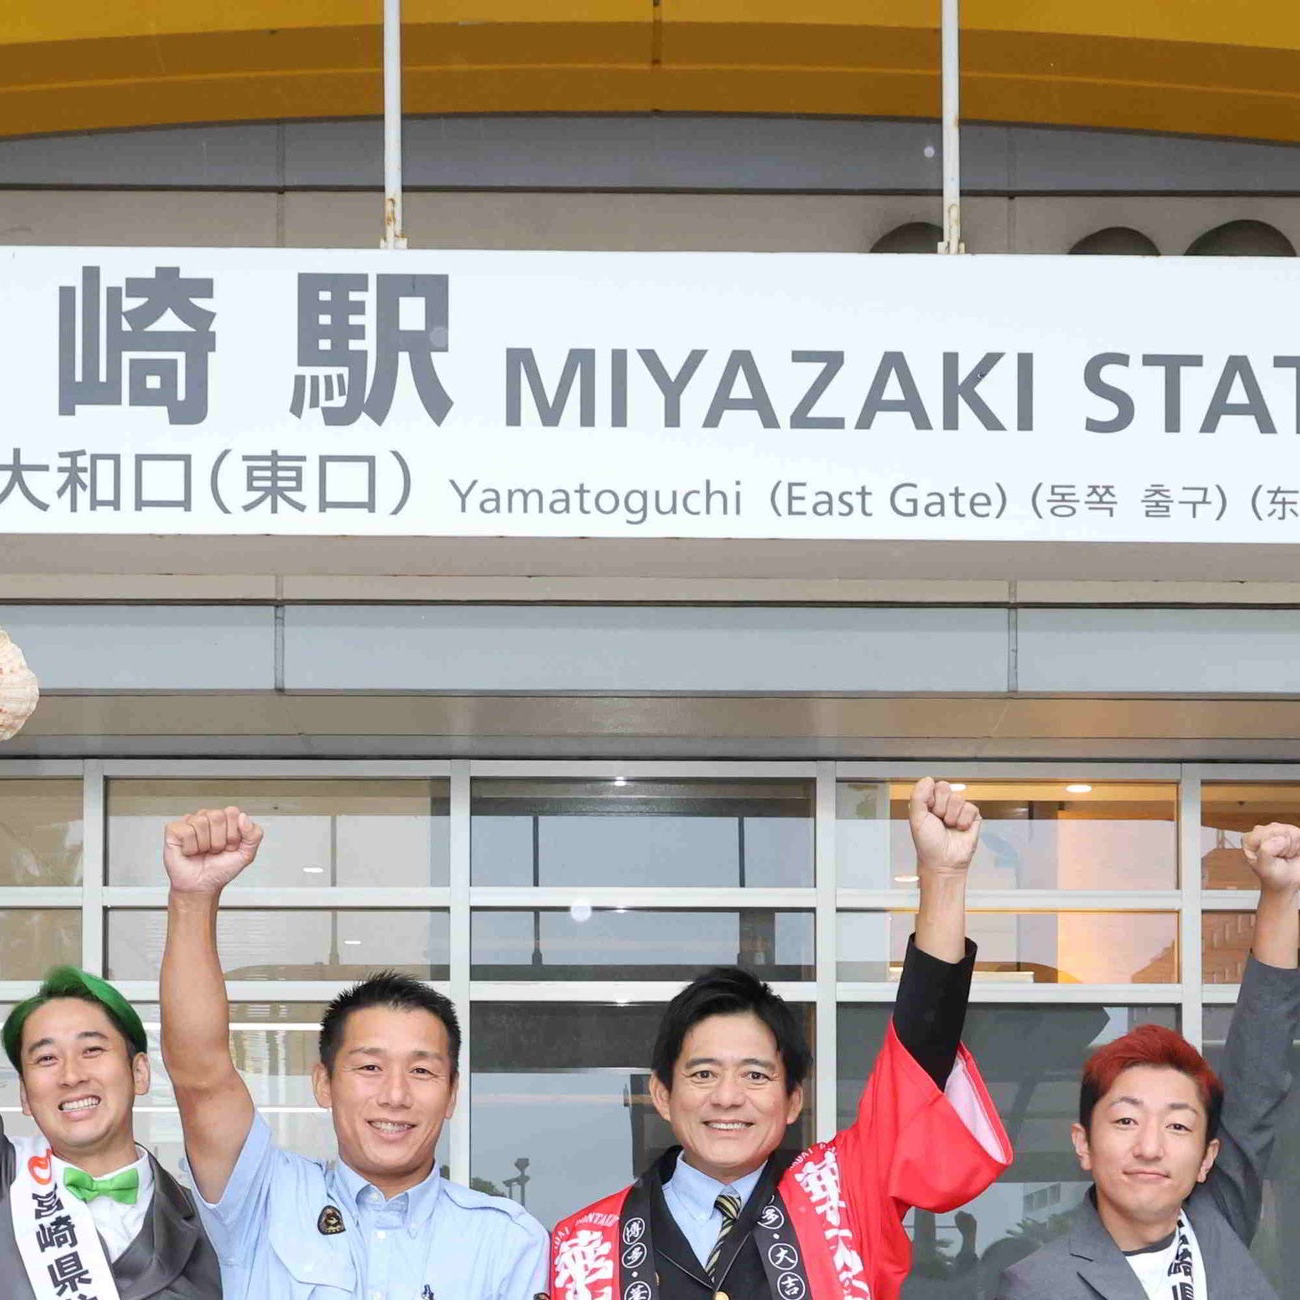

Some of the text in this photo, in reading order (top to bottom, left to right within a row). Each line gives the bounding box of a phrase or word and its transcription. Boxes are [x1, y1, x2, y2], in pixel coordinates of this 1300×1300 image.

[505, 347, 1034, 432] MIYAZAKI
[448, 478, 741, 526] Yamatoguchi
[770, 479, 873, 517] (East
[889, 482, 1008, 520] Gate)
